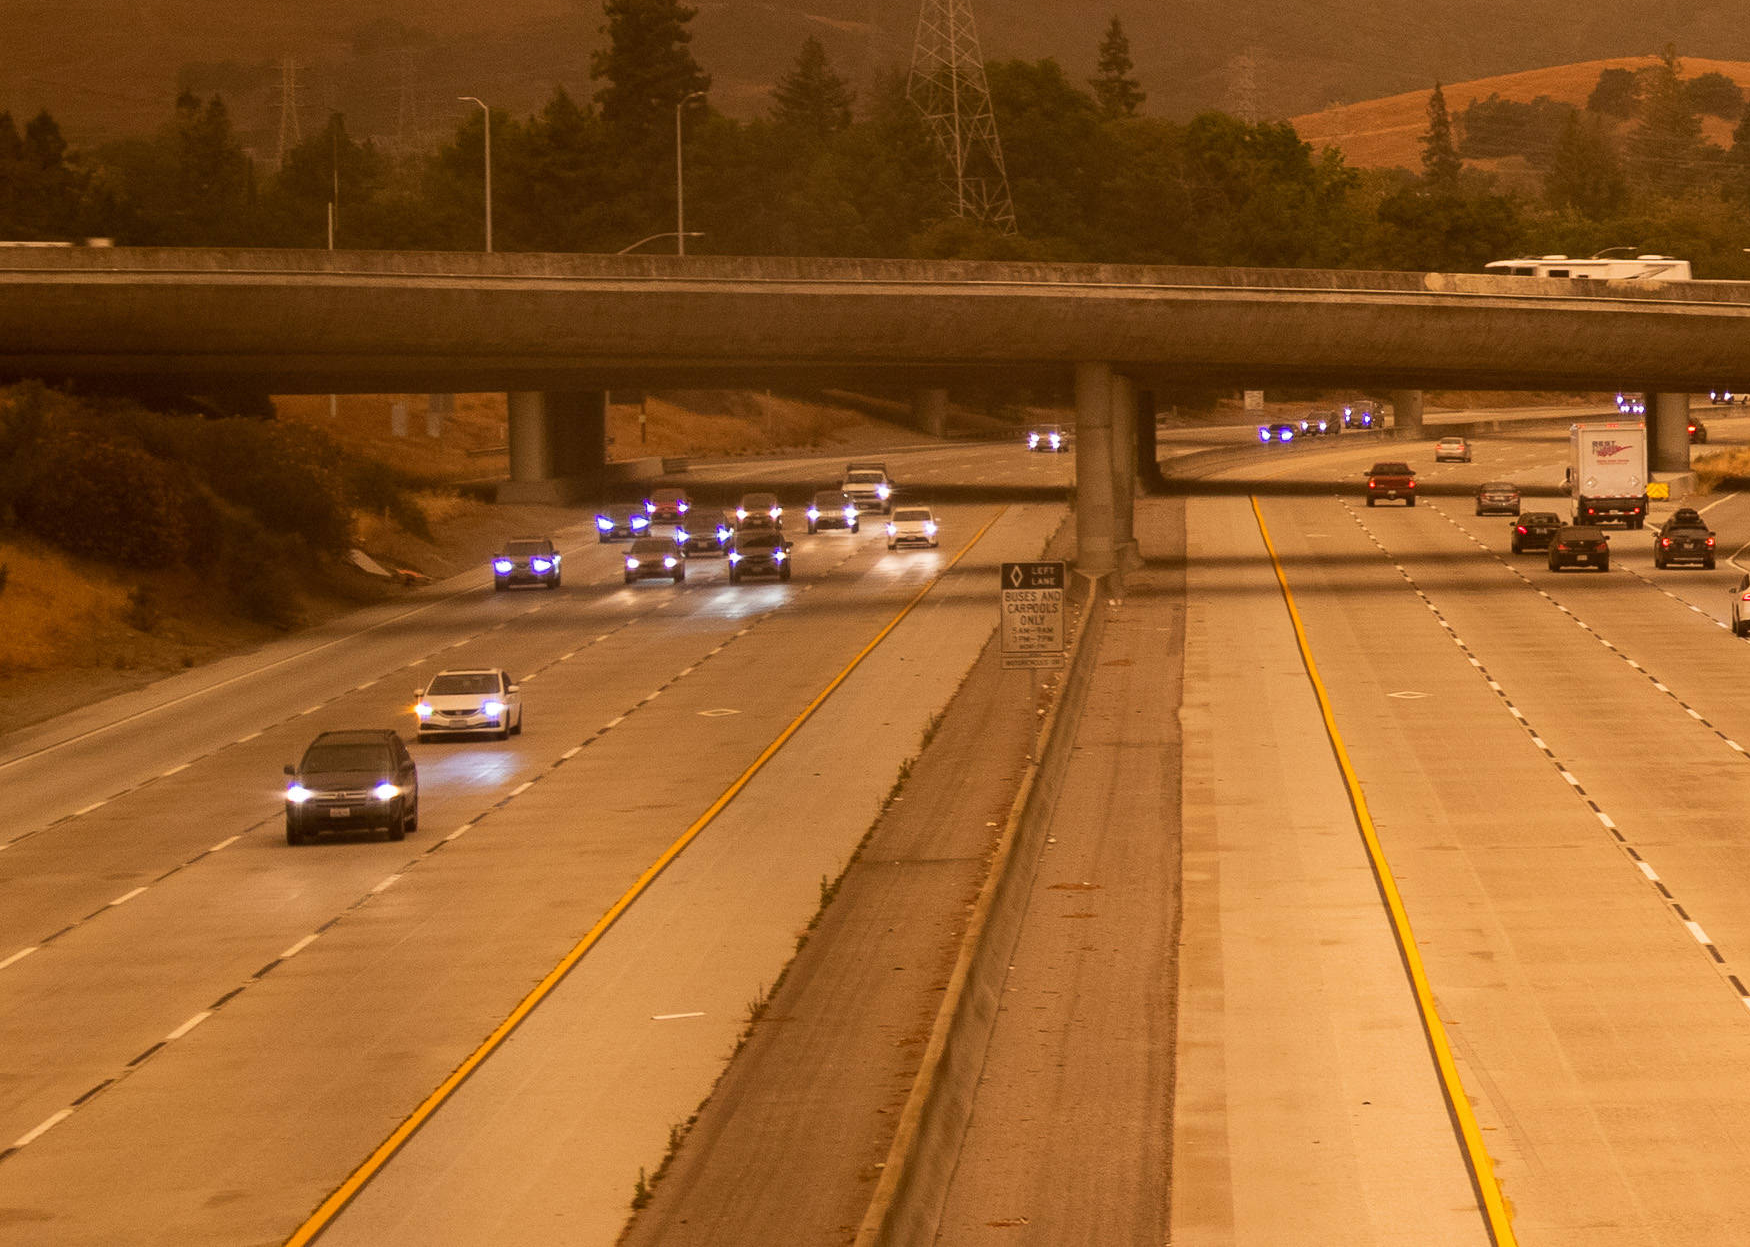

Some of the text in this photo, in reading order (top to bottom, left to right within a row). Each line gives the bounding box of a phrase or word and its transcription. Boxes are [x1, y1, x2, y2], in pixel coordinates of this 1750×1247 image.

[1031, 567, 1055, 575] LEFT
[1031, 577, 1056, 585] LANE
[1005, 591, 1061, 602] BUSES AND
[1007, 603, 1058, 614] CARPOOLS
[1020, 615, 1045, 625] ONLY
